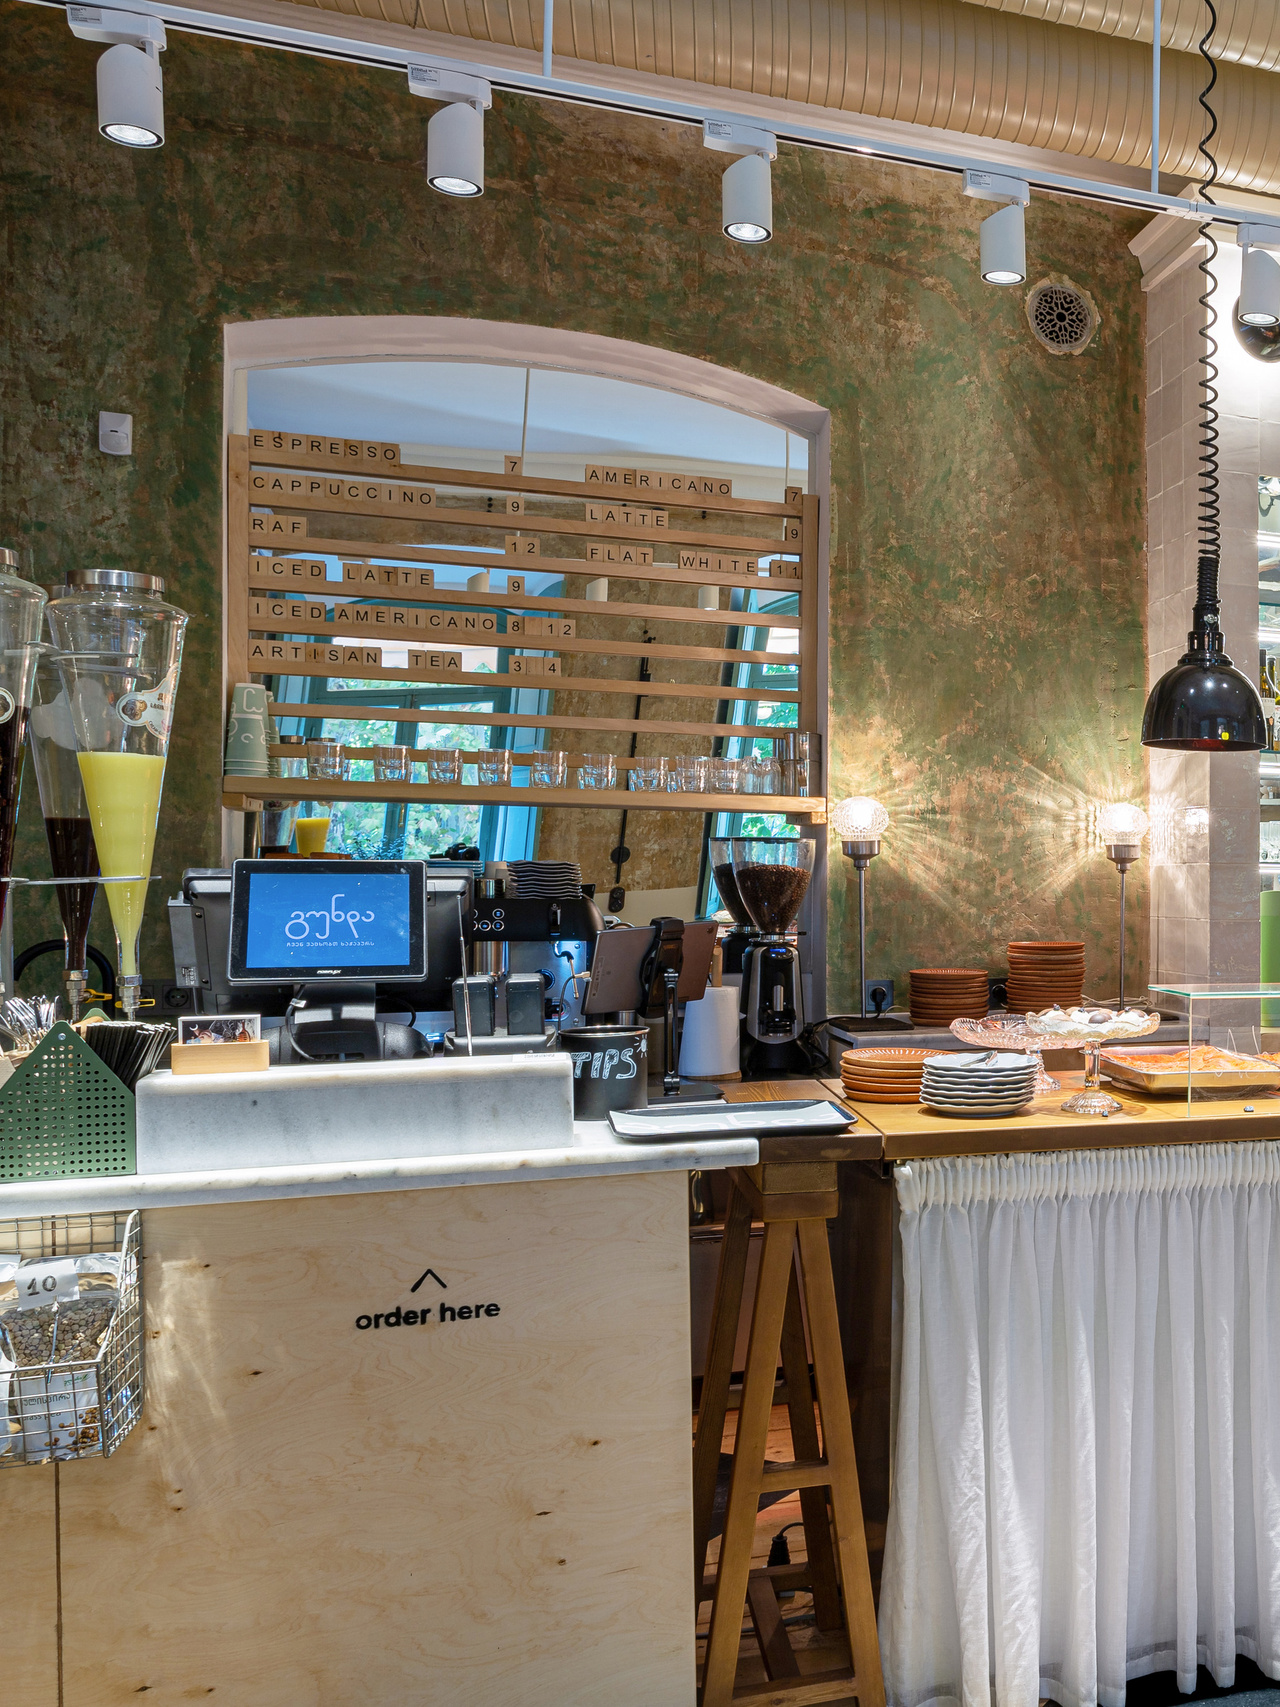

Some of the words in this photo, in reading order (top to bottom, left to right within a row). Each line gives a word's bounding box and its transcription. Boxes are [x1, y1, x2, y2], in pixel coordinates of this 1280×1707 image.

[253, 434, 397, 460] ESPRESSO
[509, 460, 518, 472] 7
[252, 476, 433, 505] CAPPUCCINO
[511, 501, 520, 513] 9
[588, 469, 731, 496] AMERICANO
[790, 490, 799, 502] 7
[252, 518, 302, 534] RAF
[511, 541, 536, 554] 12
[590, 510, 666, 527] LATTE
[790, 528, 799, 540] 9
[256, 561, 322, 577] ICED
[347, 568, 430, 586] LATTE
[511, 580, 521, 592] 9
[590, 548, 650, 564] FLAT
[681, 555, 755, 573] WHITE
[776, 564, 799, 577] 11
[256, 602, 322, 619] ICED
[337, 608, 496, 630] AMERICANO
[511, 620, 521, 632] 8
[547, 623, 572, 636] 12
[252, 645, 378, 664] ARTISAN
[411, 654, 459, 668] TEA
[513, 660, 522, 673] 3
[548, 662, 557, 674] 4
[285, 893, 375, 940] გუნდა
[572, 1047, 638, 1080] TIPS
[26, 1274, 58, 1297] 10
[355, 1306, 432, 1331] order
[439, 1302, 501, 1323] here
